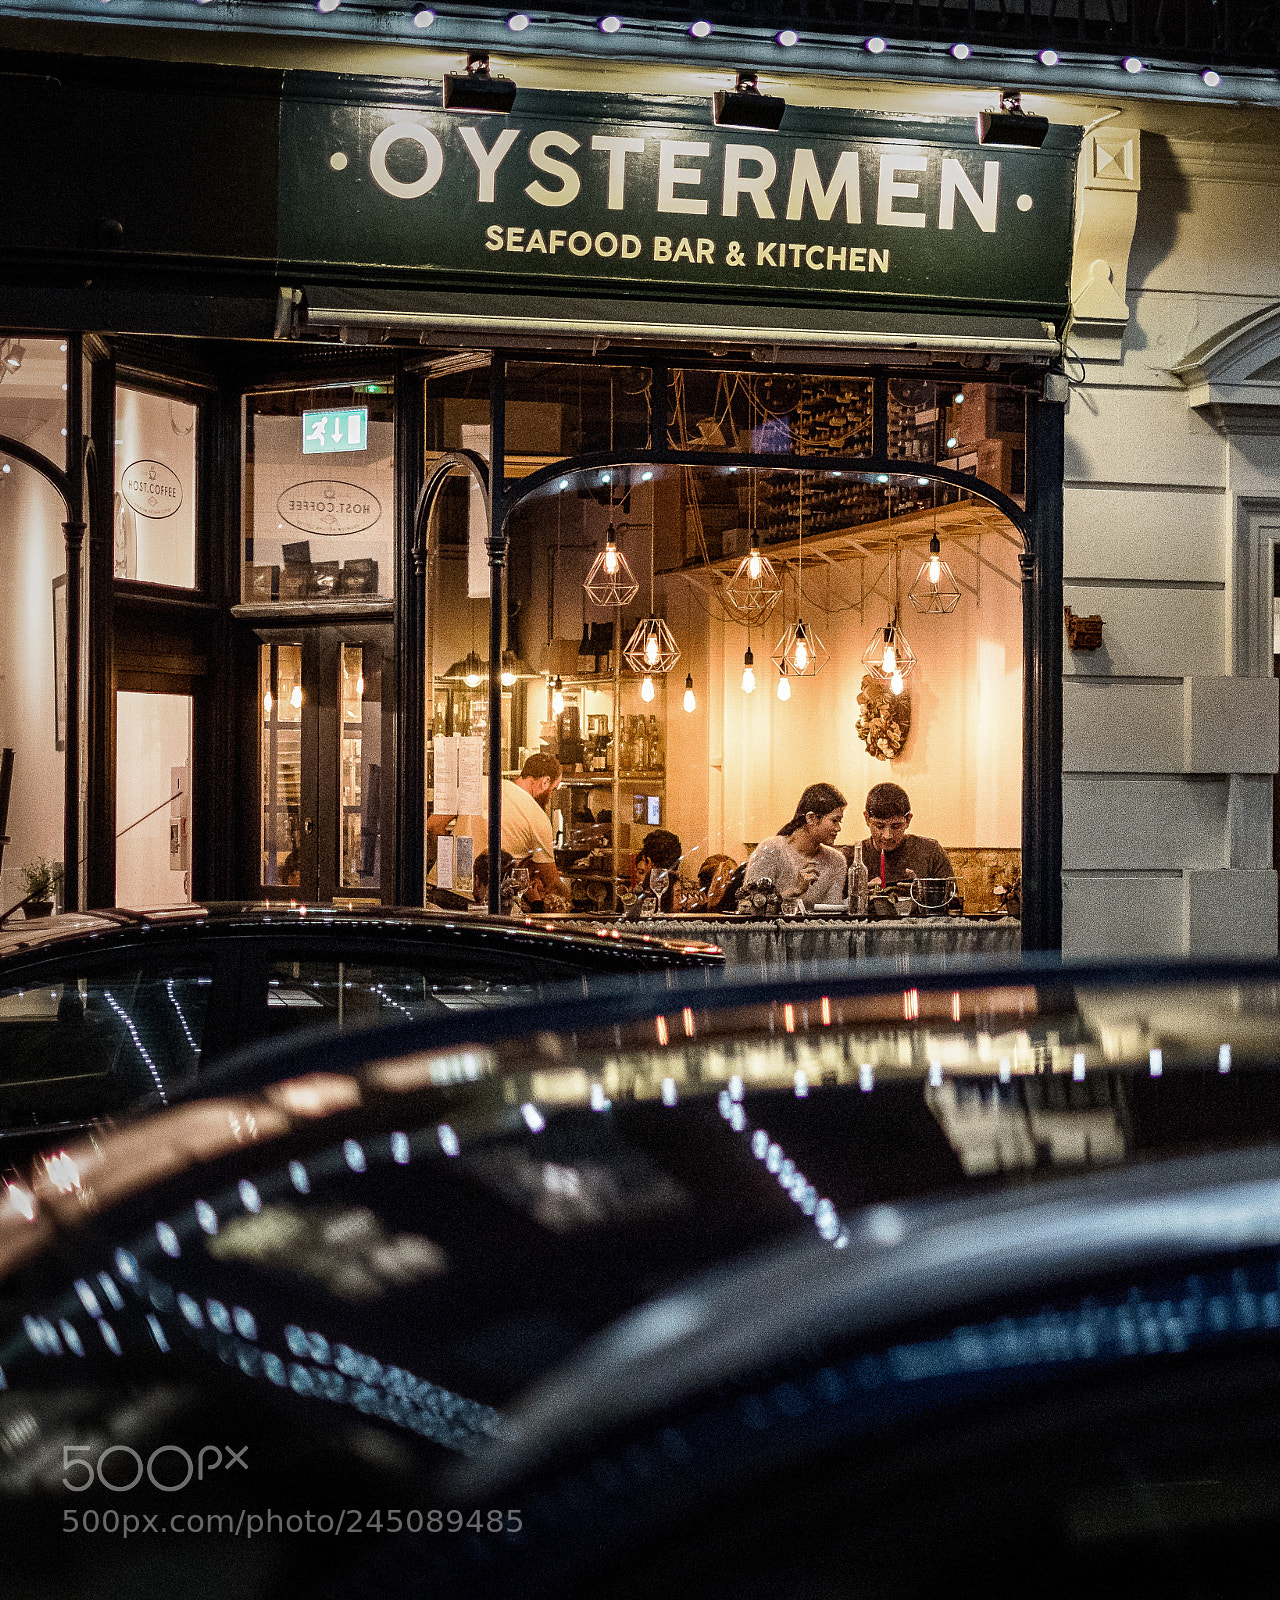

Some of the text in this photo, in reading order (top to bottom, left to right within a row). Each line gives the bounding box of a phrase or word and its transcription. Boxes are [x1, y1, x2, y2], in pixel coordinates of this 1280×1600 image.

[368, 121, 1000, 233] OYSTERMEN
[484, 224, 891, 274] SEAFOOD BAR & KITCHEN
[128, 480, 177, 498] HOST.COFFEE
